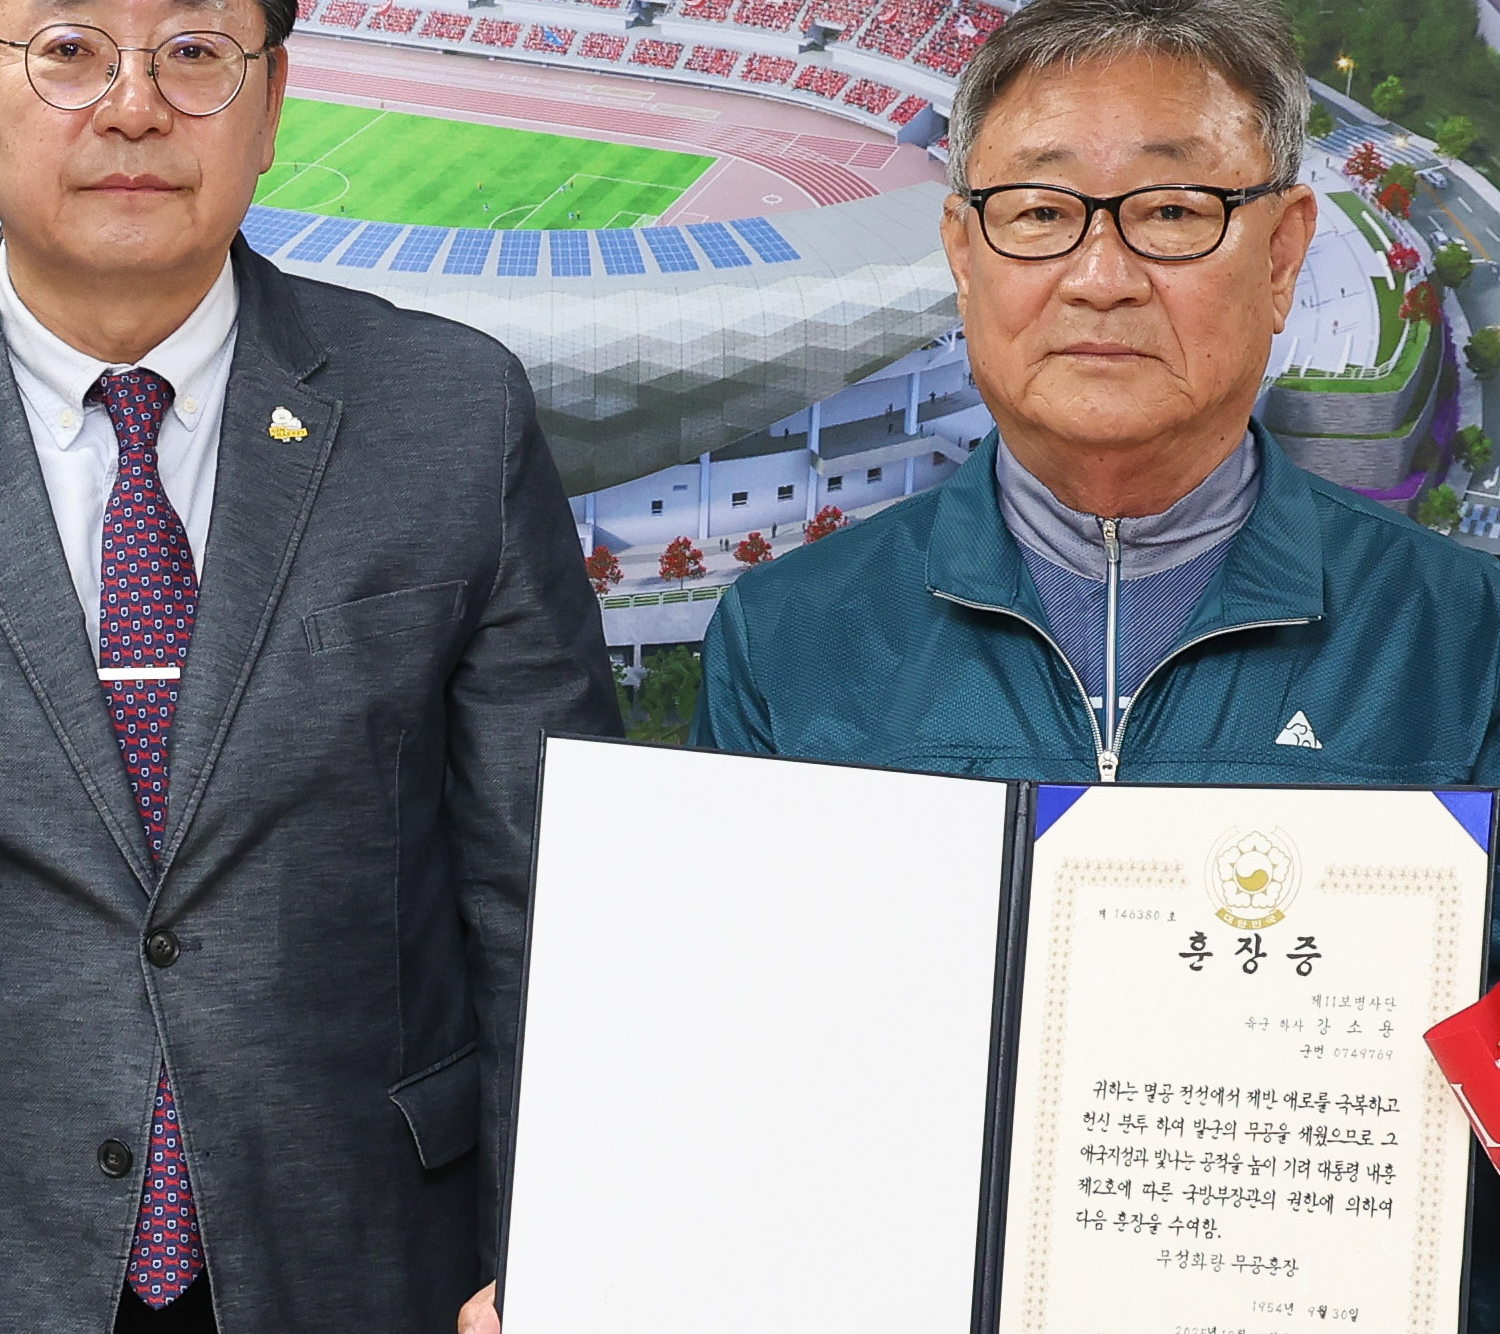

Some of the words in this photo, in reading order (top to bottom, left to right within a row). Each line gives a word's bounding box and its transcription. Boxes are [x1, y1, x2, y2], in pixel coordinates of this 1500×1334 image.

[1299, 1043, 1324, 1060] 군번
[1092, 1079, 1139, 1102] 귀하는
[1144, 1081, 1175, 1105] 멸공
[1179, 1083, 1241, 1109] 전선에서
[1246, 1087, 1279, 1111] 제반
[1282, 1090, 1332, 1114] 애로를
[1334, 1093, 1401, 1117] 극복하고
[1082, 1110, 1111, 1133] 헌신
[1117, 1113, 1149, 1136] 분투
[1156, 1115, 1185, 1138] 하여
[1193, 1117, 1238, 1142] 발군의
[1243, 1121, 1292, 1145] 무공을
[1297, 1124, 1375, 1147] 세웠으므로
[1380, 1131, 1399, 1146] 그
[1079, 1143, 1150, 1169] 애국지성과
[1154, 1147, 1196, 1172] 빛나는
[1199, 1151, 1244, 1175] 공적을
[1246, 1154, 1277, 1178] 높이
[1283, 1156, 1311, 1180] 기려
[1317, 1159, 1360, 1183] 대통령
[1366, 1162, 1397, 1186] 내훈
[1077, 1175, 1132, 1200] 제2호에
[1142, 1180, 1174, 1203] 따른
[1181, 1183, 1277, 1211] 국방부장관의
[1286, 1190, 1335, 1216] 권한에
[1344, 1194, 1393, 1220] 의하여
[1075, 1208, 1108, 1231] 다음
[1112, 1210, 1163, 1236] 훈장을
[1167, 1215, 1222, 1240] 수여함.
[1156, 1249, 1225, 1273] 무성화랑
[1231, 1254, 1299, 1278] 무공훈장
